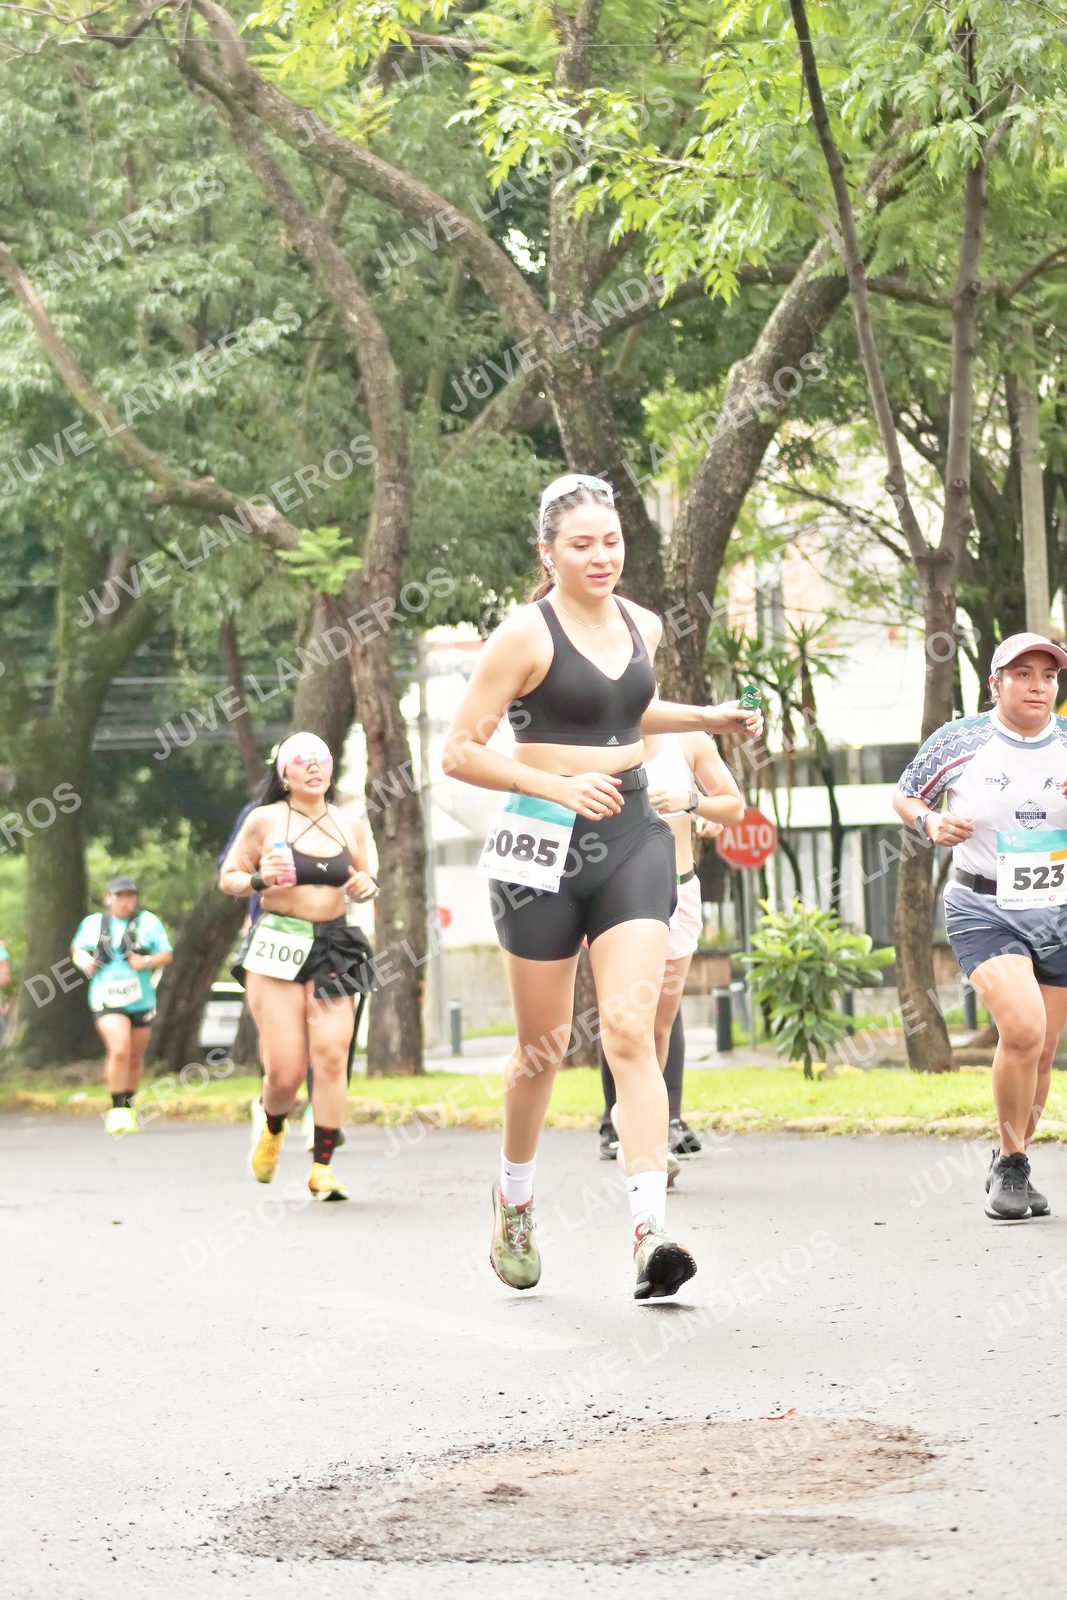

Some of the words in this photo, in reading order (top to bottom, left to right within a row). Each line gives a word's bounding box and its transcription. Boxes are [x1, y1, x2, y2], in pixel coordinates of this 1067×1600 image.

[721, 824, 773, 849] ALTO
[1013, 864, 1065, 890] 523
[255, 941, 305, 966] 2100
